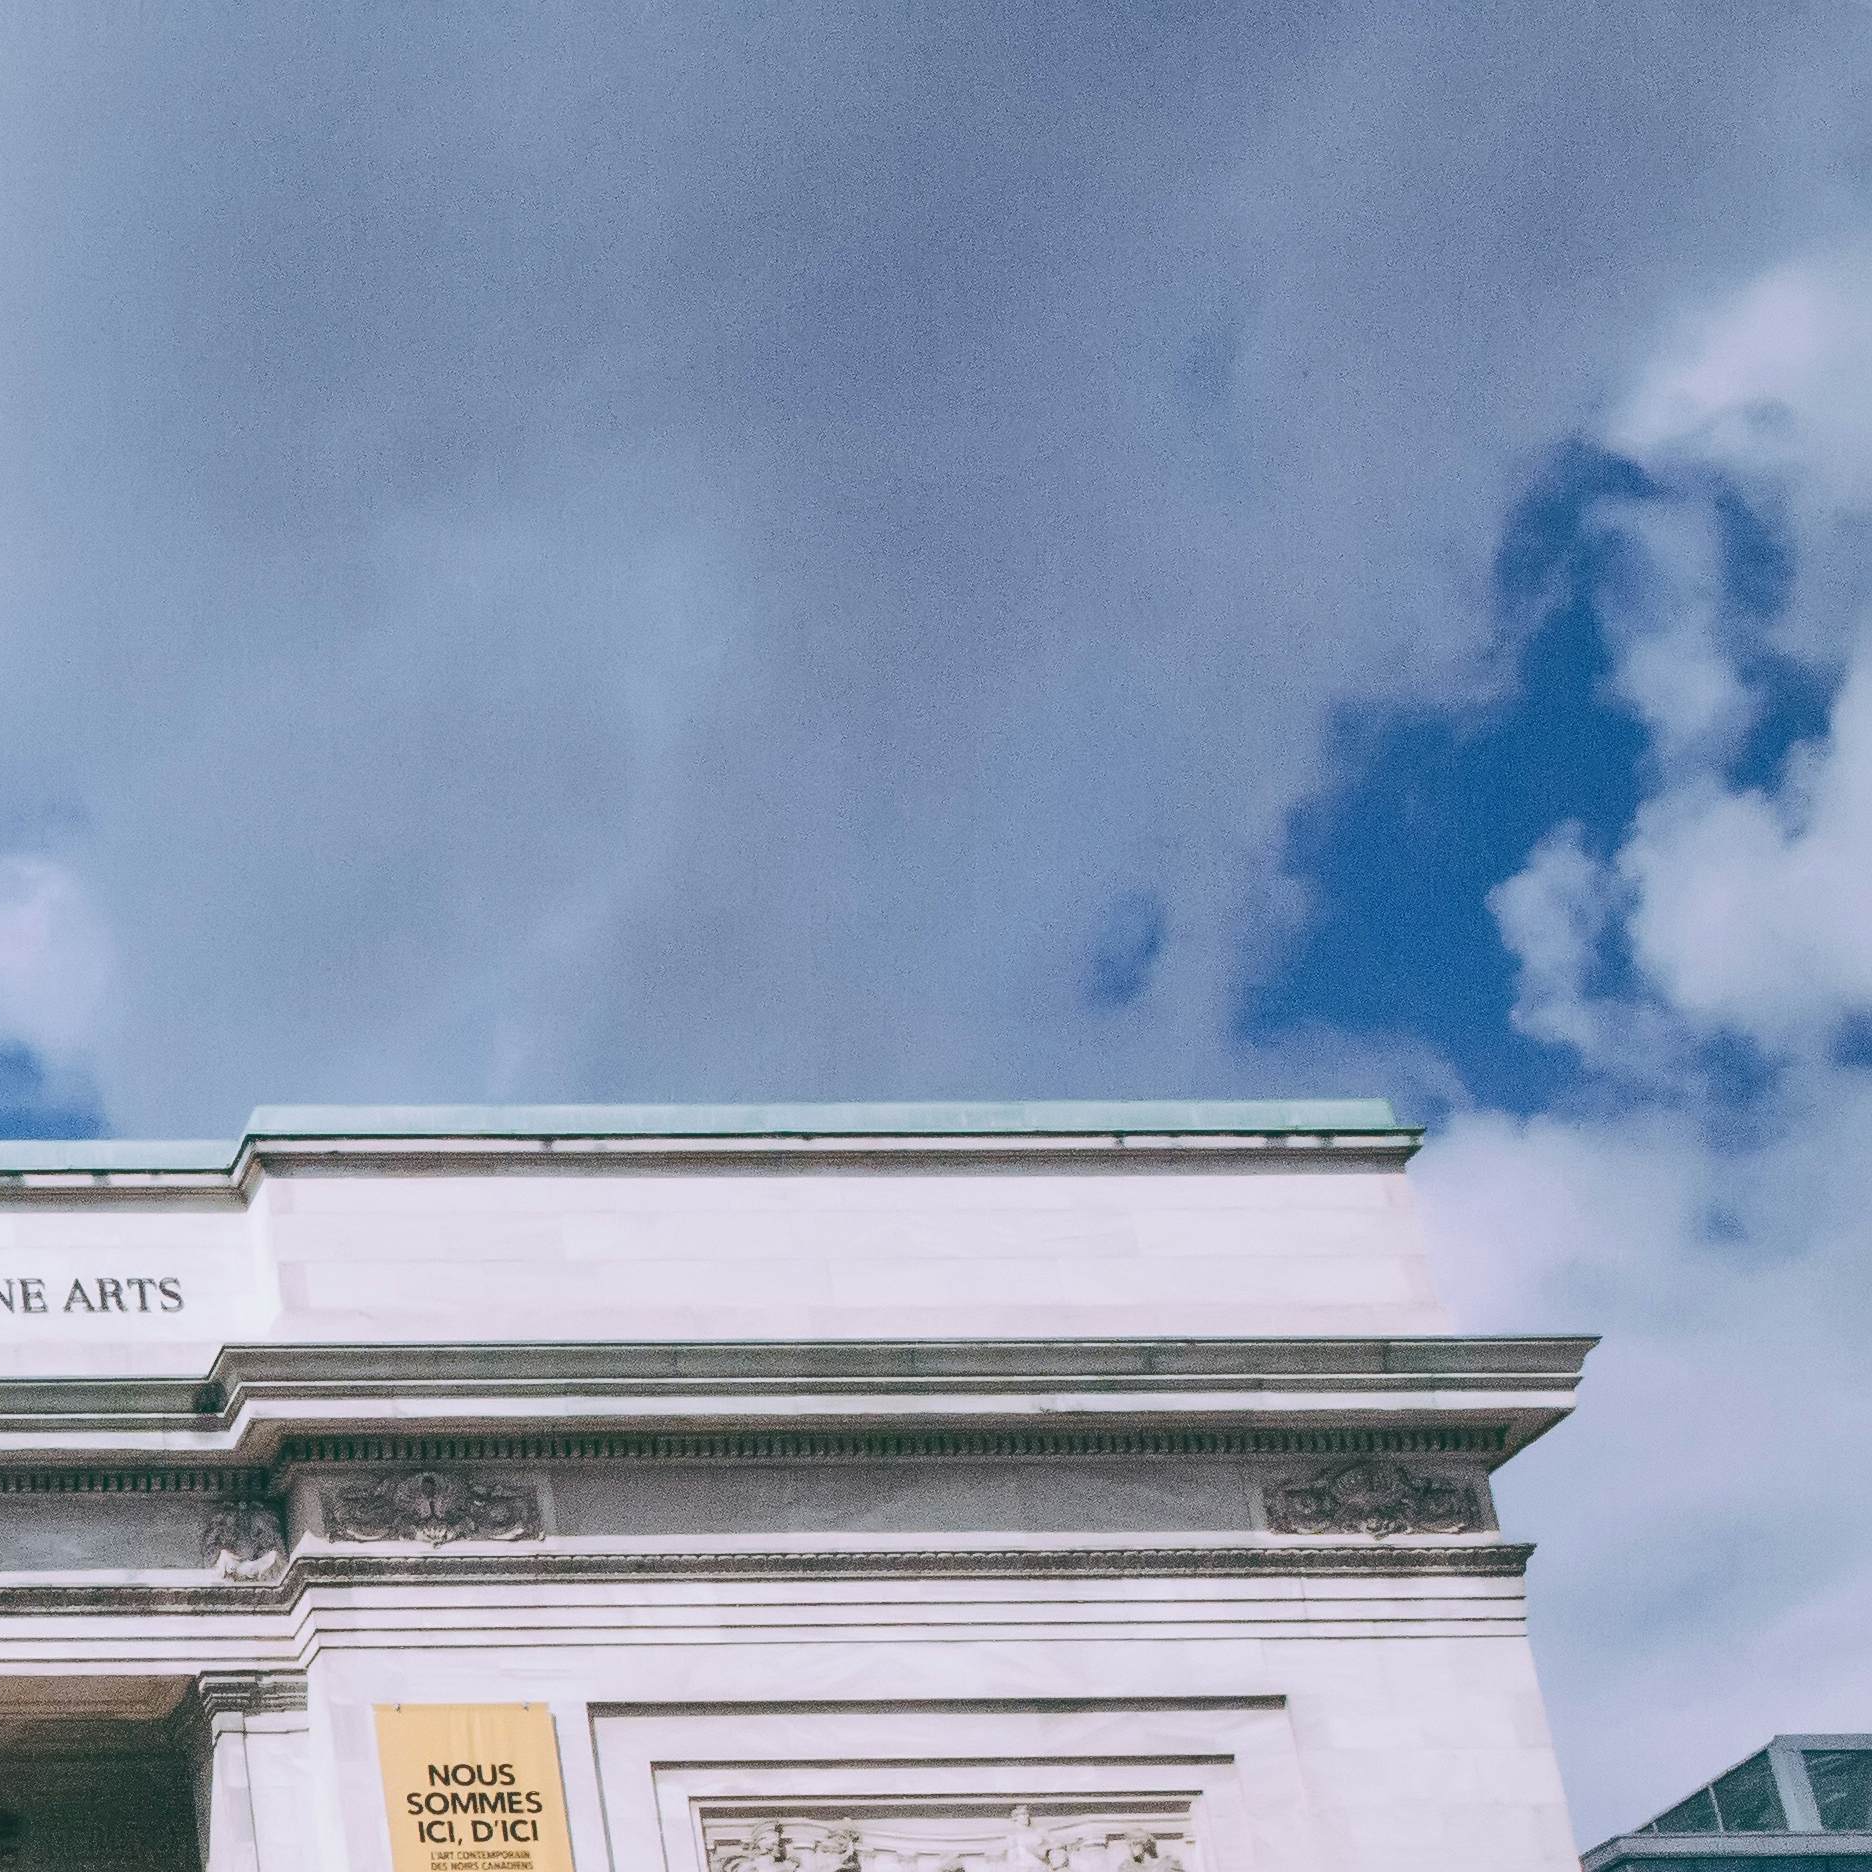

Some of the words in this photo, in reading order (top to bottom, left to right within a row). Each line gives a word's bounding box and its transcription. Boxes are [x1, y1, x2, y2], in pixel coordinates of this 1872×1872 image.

[62, 1277, 185, 1313] ARTS
[427, 1763, 516, 1787] NOUS
[406, 1790, 543, 1815] SOMMES
[417, 1820, 463, 1846] ICI,
[470, 1819, 540, 1843] D'ICI
[430, 1861, 448, 1872] DES
[450, 1861, 480, 1872] NOIRS
[481, 1861, 534, 1871] CANADIENS
[456, 1850, 531, 1860] CONTEMPORAIN
